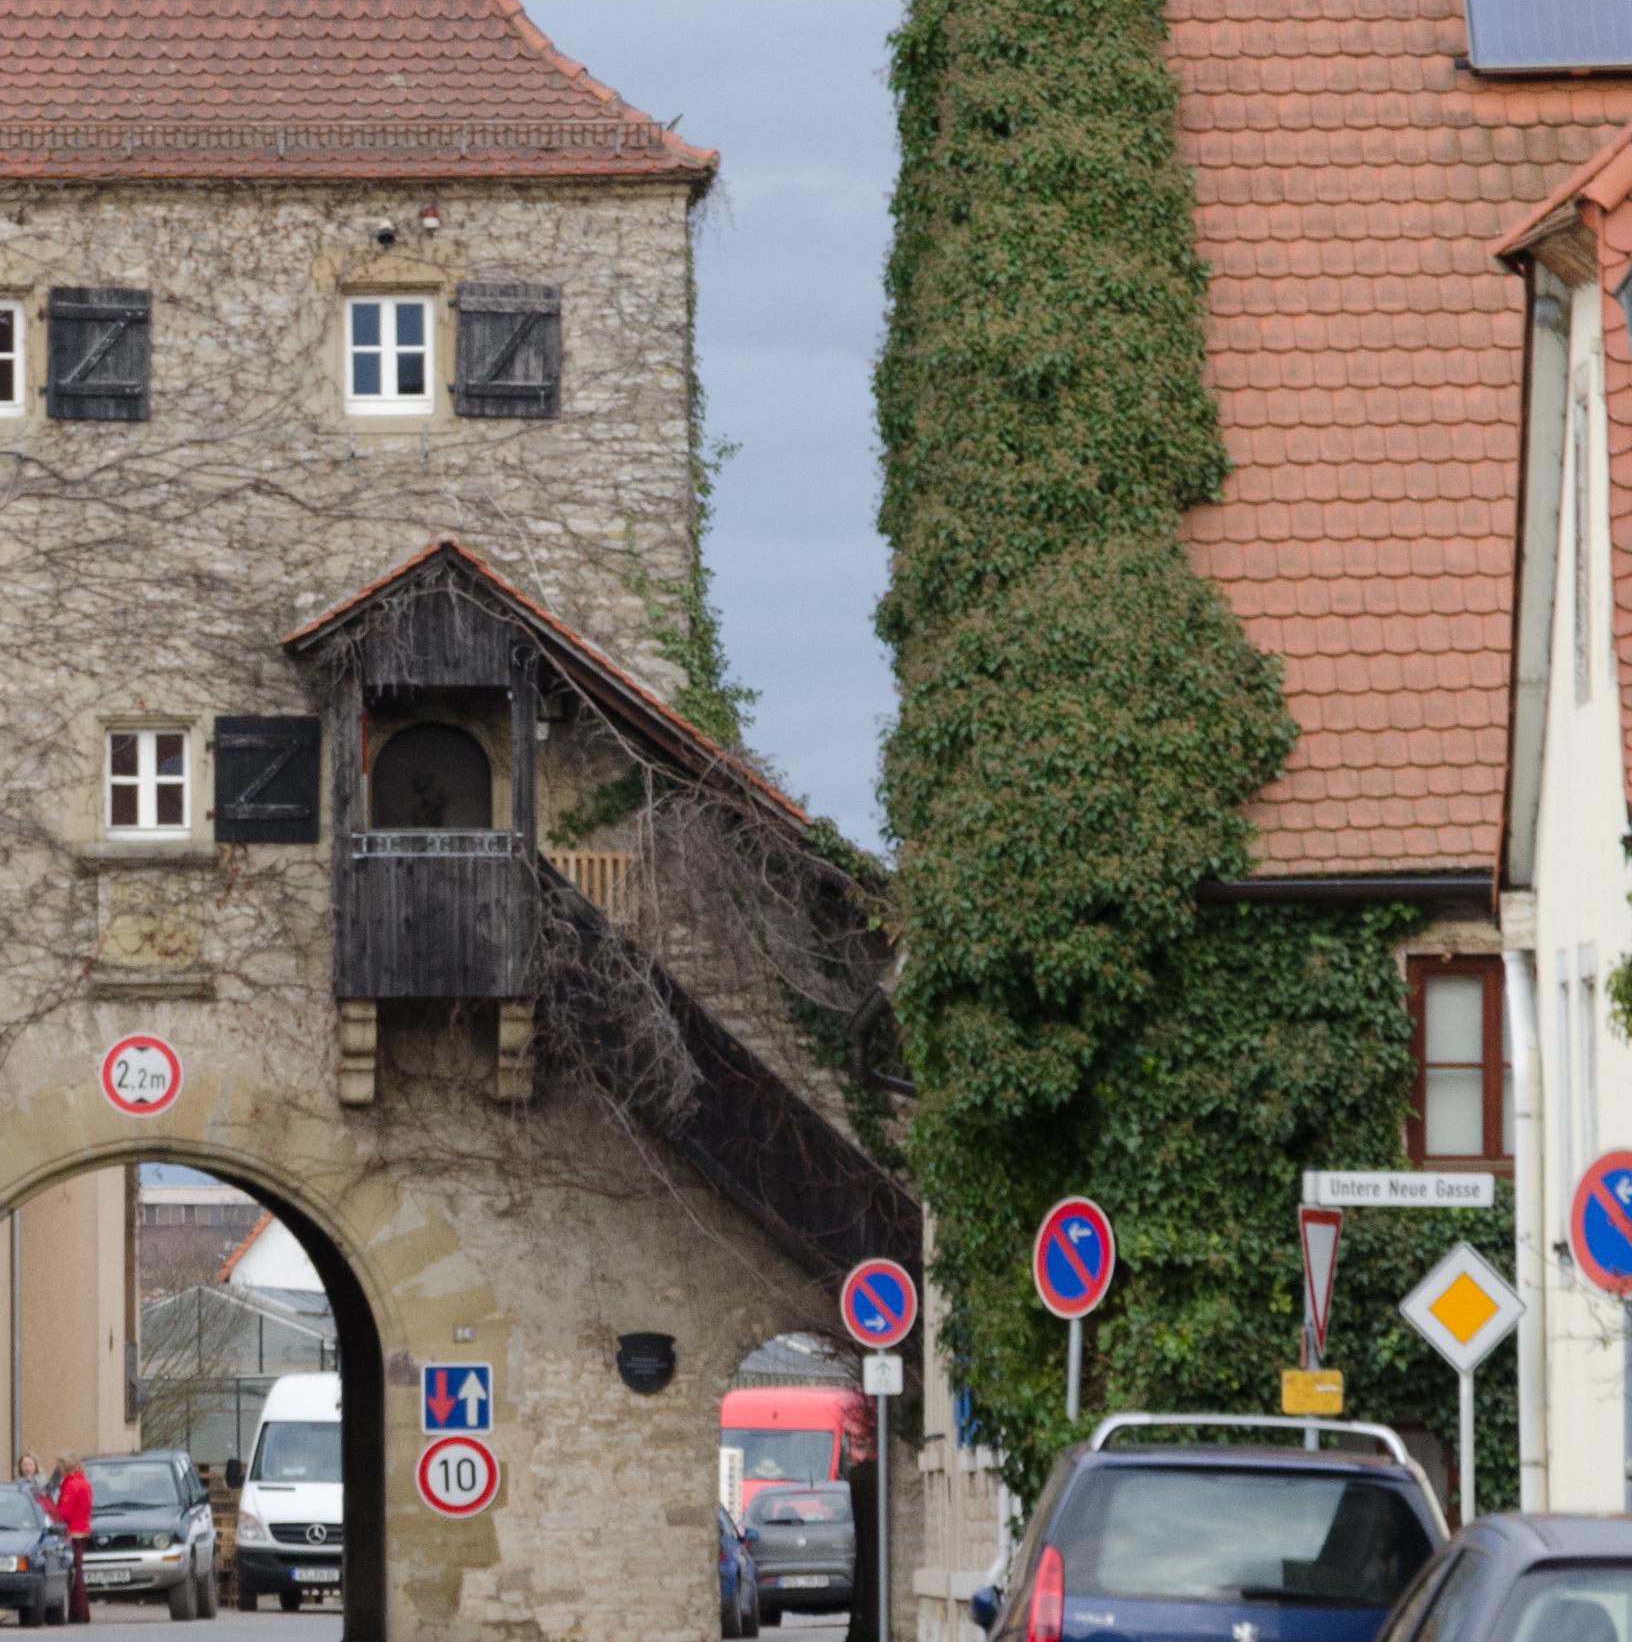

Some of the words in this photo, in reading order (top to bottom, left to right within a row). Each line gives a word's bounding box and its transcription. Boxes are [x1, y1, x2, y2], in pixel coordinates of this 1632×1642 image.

[1329, 1177, 1381, 1197] Untere
[1388, 1178, 1428, 1198] Neue
[1435, 1178, 1481, 1198] Gasse
[439, 1458, 477, 1493] 10
